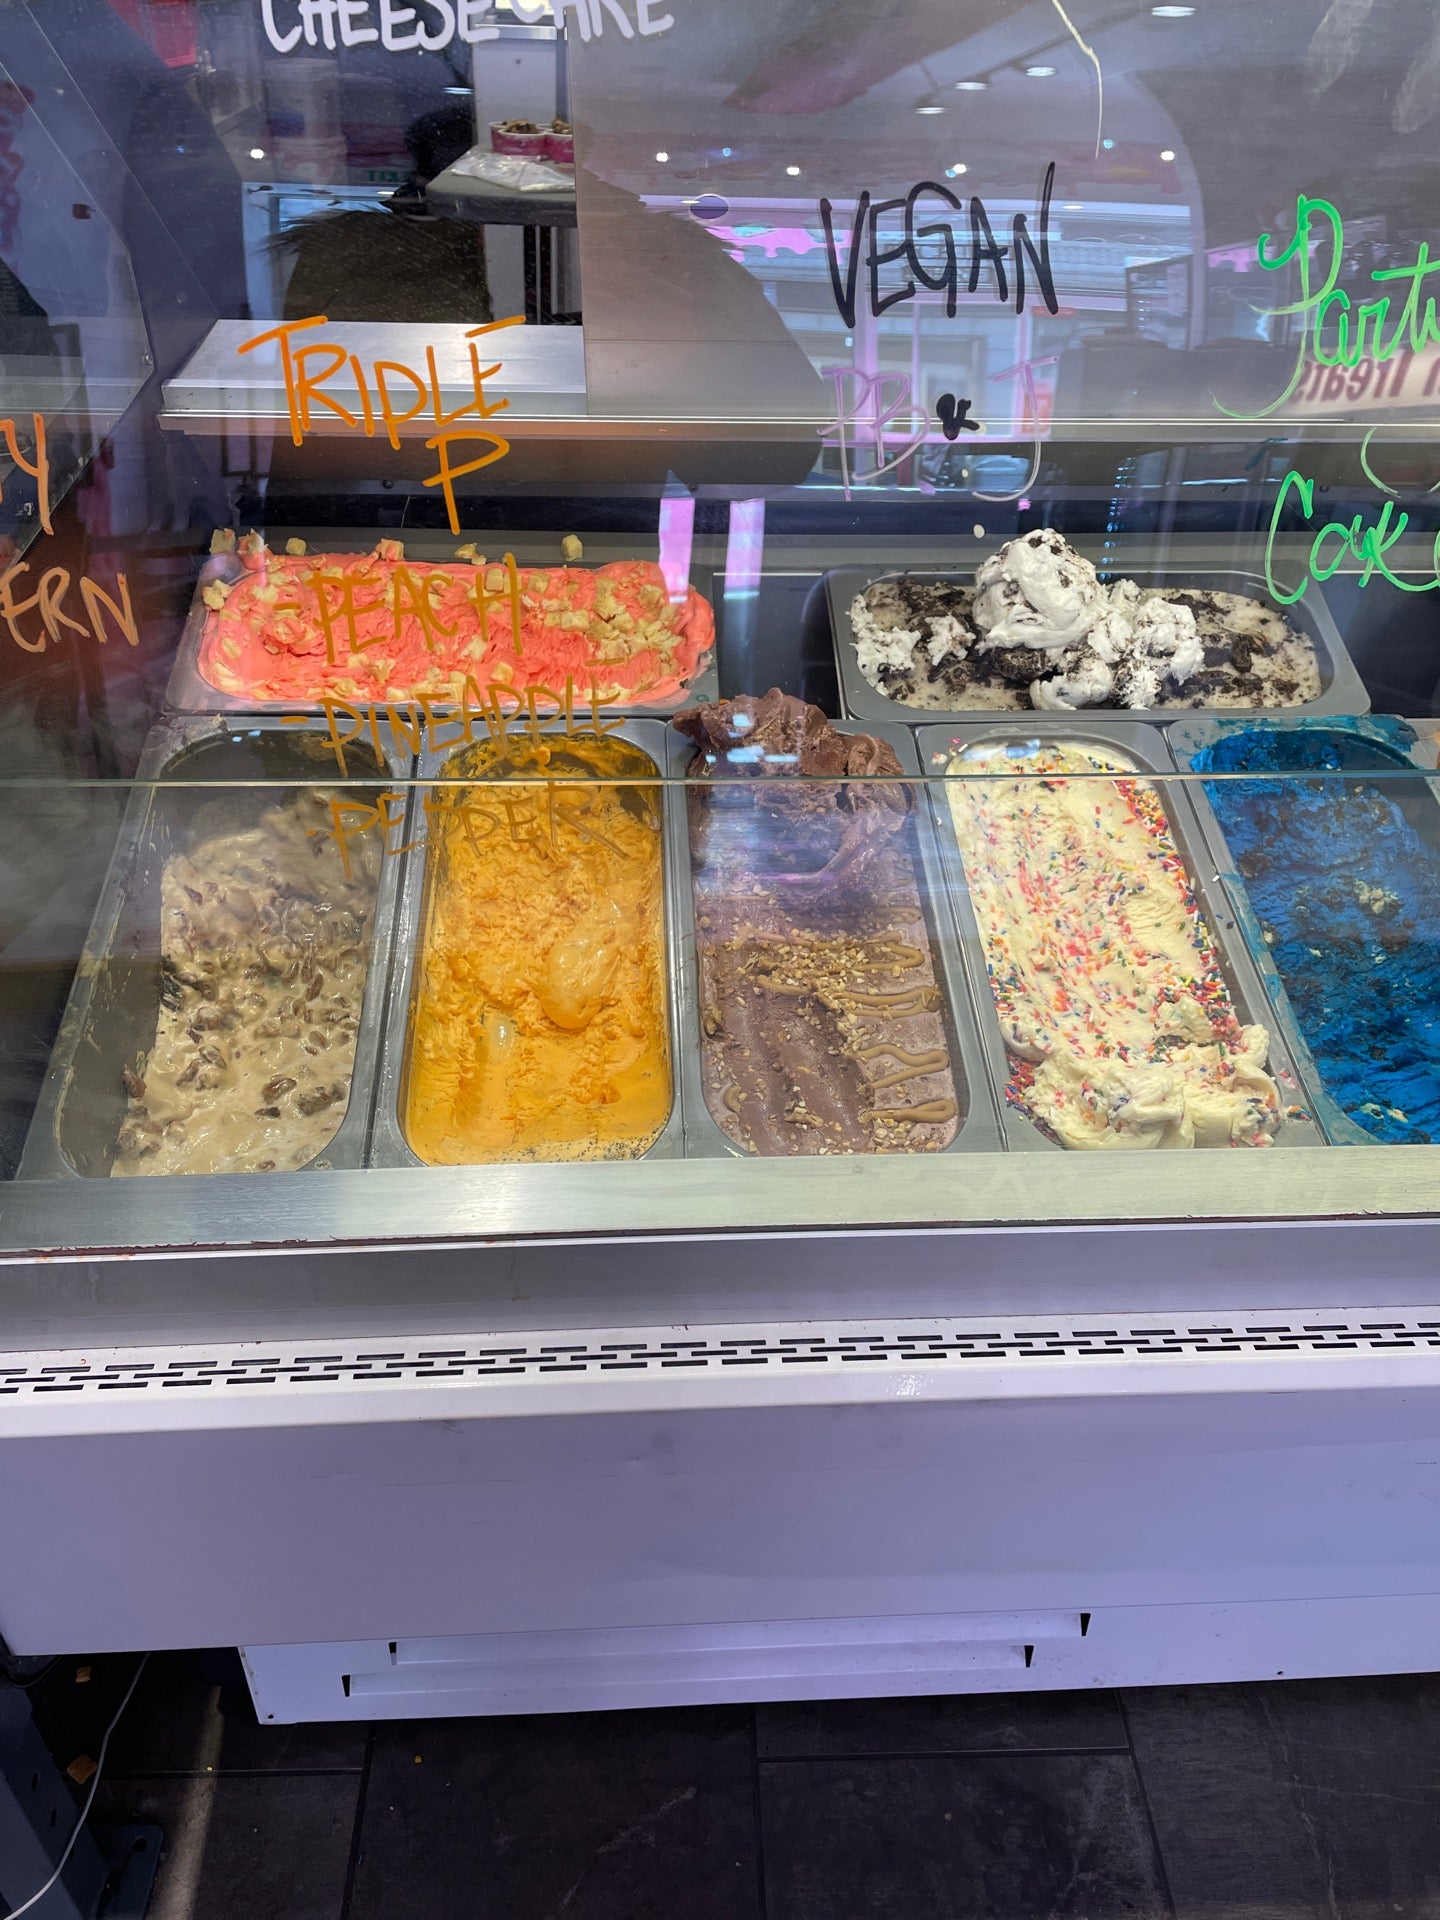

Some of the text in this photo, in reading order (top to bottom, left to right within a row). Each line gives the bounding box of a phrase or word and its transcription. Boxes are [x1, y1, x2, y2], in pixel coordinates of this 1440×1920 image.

[820, 162, 1059, 328] VEGAN
[238, 316, 526, 449] TRIPLE
[816, 367, 931, 502] PB
[971, 356, 1060, 502] J
[422, 430, 510, 535] P
[1265, 470, 1440, 605] Cak
